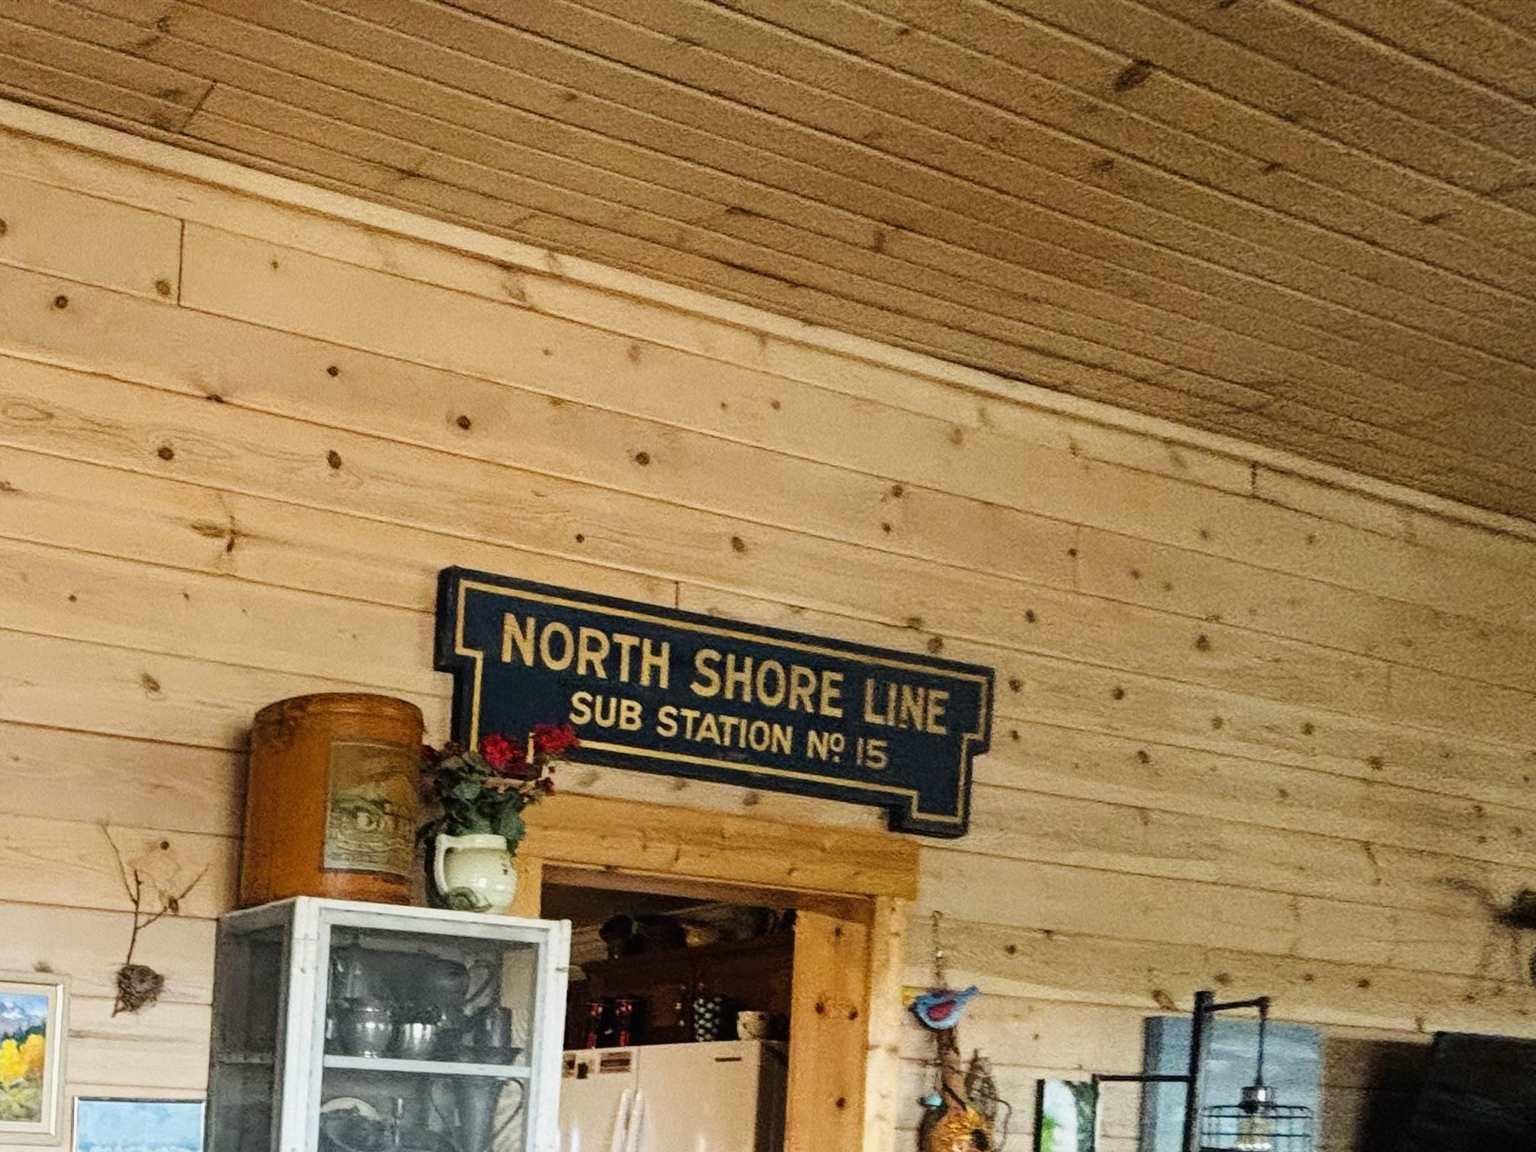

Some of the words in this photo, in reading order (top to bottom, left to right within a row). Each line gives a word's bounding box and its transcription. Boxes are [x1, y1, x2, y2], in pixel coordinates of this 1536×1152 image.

[500, 611, 671, 690] NORTH
[689, 647, 844, 719] SHORE
[863, 677, 950, 736] LINE
[569, 690, 643, 732] SUB
[655, 704, 794, 756] STATION
[855, 736, 889, 770] 15
